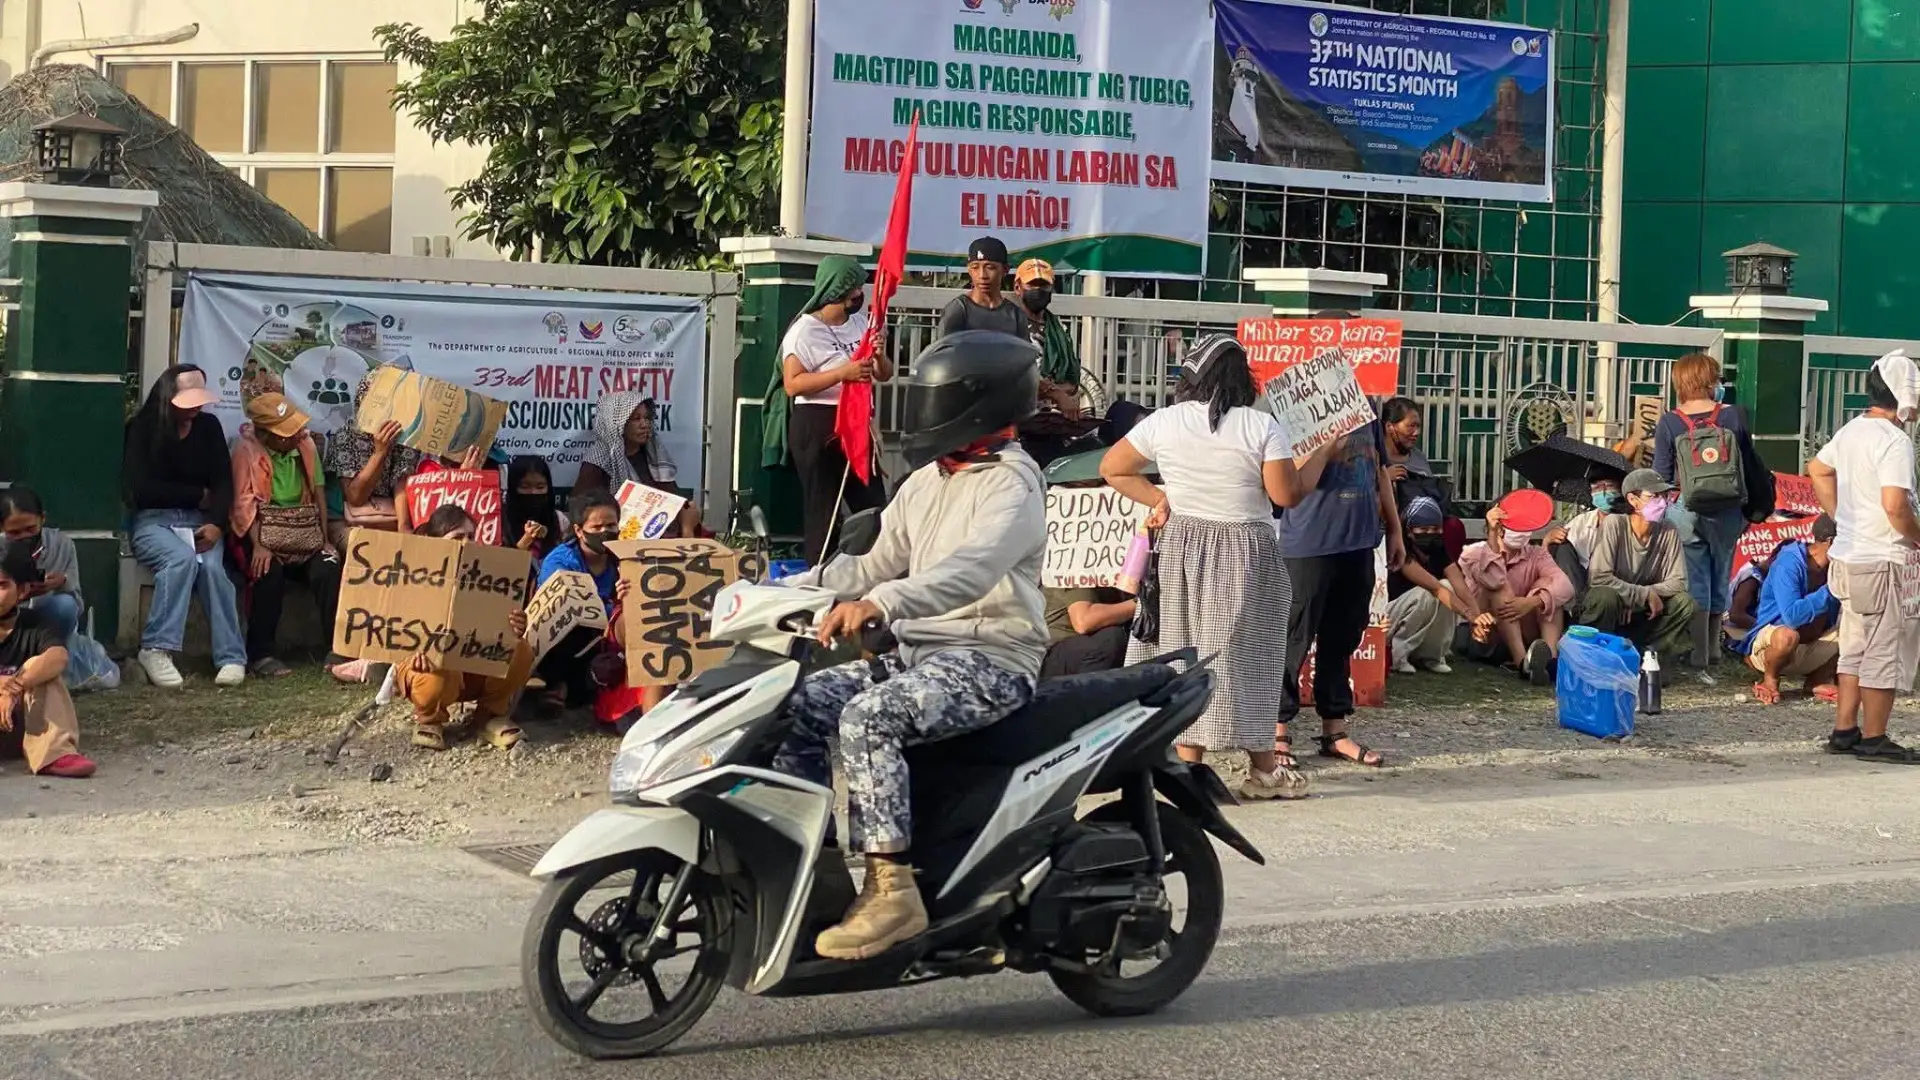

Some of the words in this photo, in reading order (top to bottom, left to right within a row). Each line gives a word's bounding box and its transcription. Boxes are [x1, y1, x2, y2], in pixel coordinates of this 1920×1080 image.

[954, 24, 1082, 63] MAGHANDA,
[1331, 18, 1373, 28] DEPARTMENT
[1373, 21, 1382, 29] OF
[1383, 23, 1425, 33] AGRICULTURE
[1429, 27, 1460, 38] REGIONAL
[1461, 30, 1477, 39] FIELD
[1380, 32, 1410, 42] celebrating
[1309, 38, 1353, 64] 37TH
[1356, 43, 1458, 76] NATIONAL
[833, 53, 938, 88] MAGTIPID
[945, 63, 974, 91] SA
[980, 66, 1091, 98] PAGGAMIT
[1099, 73, 1125, 101] NG
[1129, 76, 1194, 109] TUBIG,
[1308, 67, 1397, 93] STATISTICS
[1399, 75, 1458, 99] MONTH
[893, 98, 981, 129] MAGING
[988, 107, 1137, 141] RESPONSABLE,
[1353, 98, 1380, 109] TUKLAS
[1381, 100, 1415, 112] PILIPINAS
[844, 138, 1048, 181] MAGTULUNGAN
[1056, 150, 1139, 186] LABAN
[1145, 155, 1178, 189] SA
[961, 193, 990, 227] EL
[997, 189, 1071, 231] NIÑO!
[1243, 322, 1305, 342] Militar
[1309, 325, 1334, 342] sa
[428, 342, 443, 351] The
[444, 342, 493, 352] DEPARTMENT
[496, 344, 506, 353] OF
[508, 346, 558, 355] AGRICULTURE
[568, 348, 604, 357] REGIONAL
[606, 350, 625, 358] FIELD
[627, 350, 652, 359] OFFICE
[472, 367, 535, 388] 33rd
[534, 364, 594, 400] MEAT
[534, 438, 559, 448] One
[1045, 491, 1135, 518] PUDNO
[348, 541, 449, 588] Sahod
[459, 559, 525, 600] itaas
[1047, 548, 1075, 570] ITI
[1054, 574, 1109, 588] TULONG
[345, 607, 459, 653] PRESYO
[635, 548, 693, 681] SAHOD
